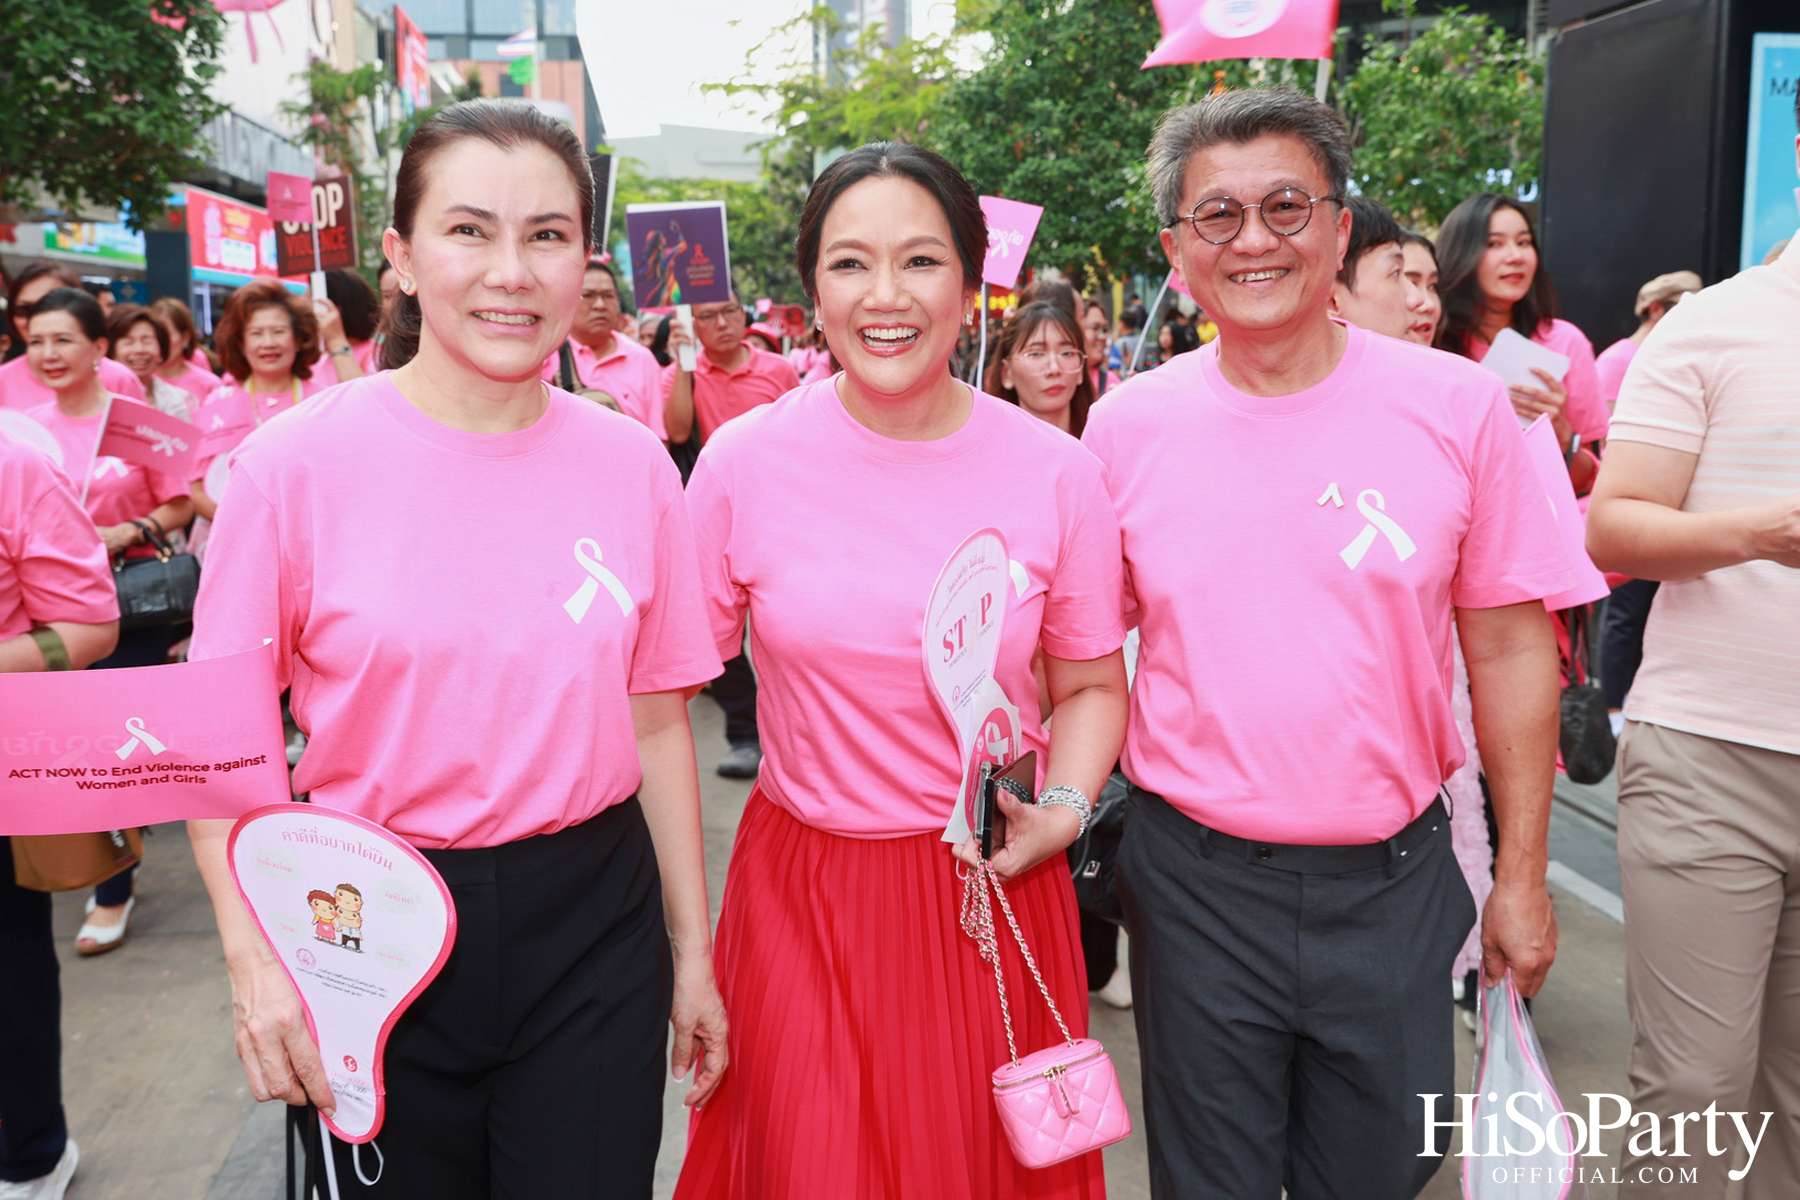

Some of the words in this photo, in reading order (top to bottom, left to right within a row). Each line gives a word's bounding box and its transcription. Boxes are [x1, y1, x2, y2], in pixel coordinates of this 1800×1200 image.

[284, 226, 347, 257] VIOLNCE
[8, 768, 42, 778] ACT
[45, 767, 88, 777] NOW
[91, 767, 108, 776] to
[111, 765, 142, 776] End
[145, 763, 211, 772] Violence
[213, 754, 267, 772] against
[76, 779, 137, 790] Women
[140, 774, 169, 785] and
[173, 774, 207, 784] Girls
